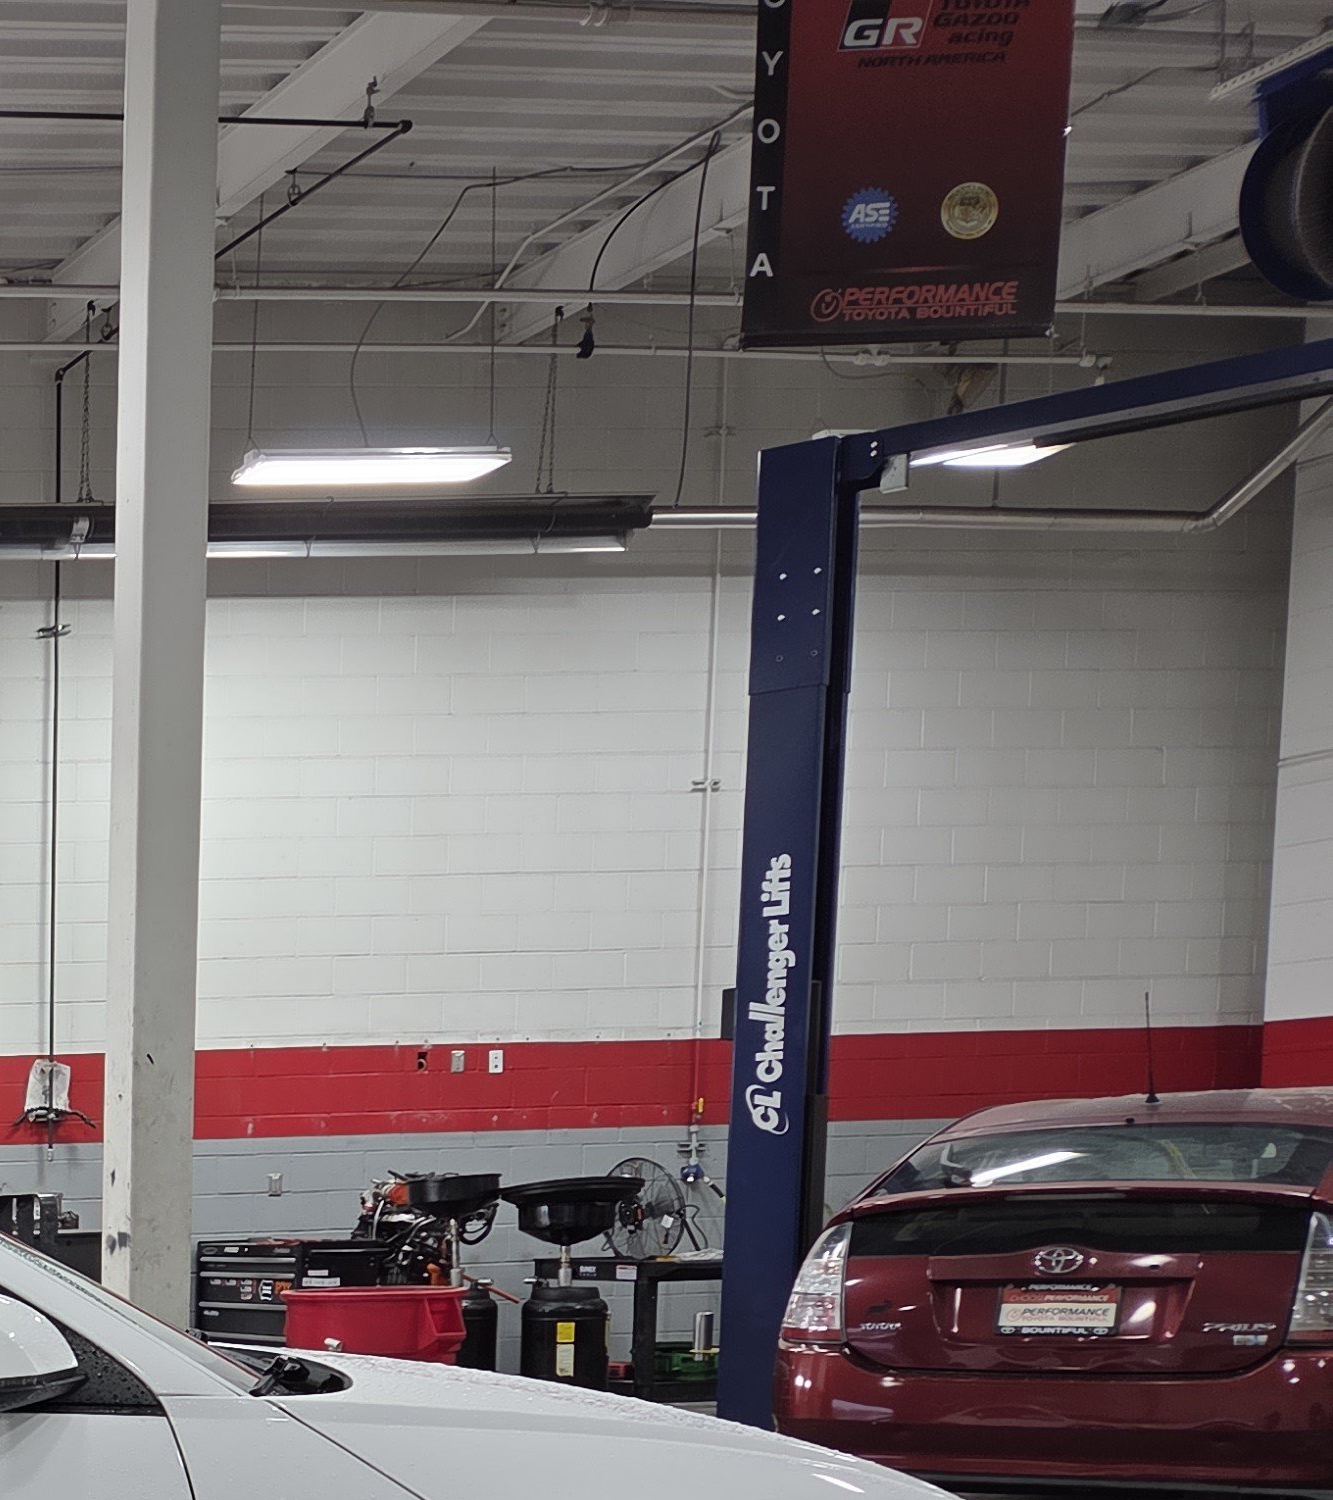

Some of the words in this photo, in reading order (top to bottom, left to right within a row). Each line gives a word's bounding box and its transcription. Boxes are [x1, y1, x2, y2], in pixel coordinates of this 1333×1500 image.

[934, 12, 1021, 27] GAZOO
[842, 17, 924, 47] GR
[857, 55, 921, 69] NORTH
[923, 51, 1007, 66] AMERICA
[848, 201, 891, 224] ASE
[843, 281, 1019, 306] PERFORMANCE
[843, 306, 911, 322] TOYOTA
[916, 303, 1018, 319] BOUNTIFUL
[760, 853, 792, 918] Lifts
[748, 919, 796, 1084] Challenger
[1021, 1307, 1111, 1316] PERFORMANCE
